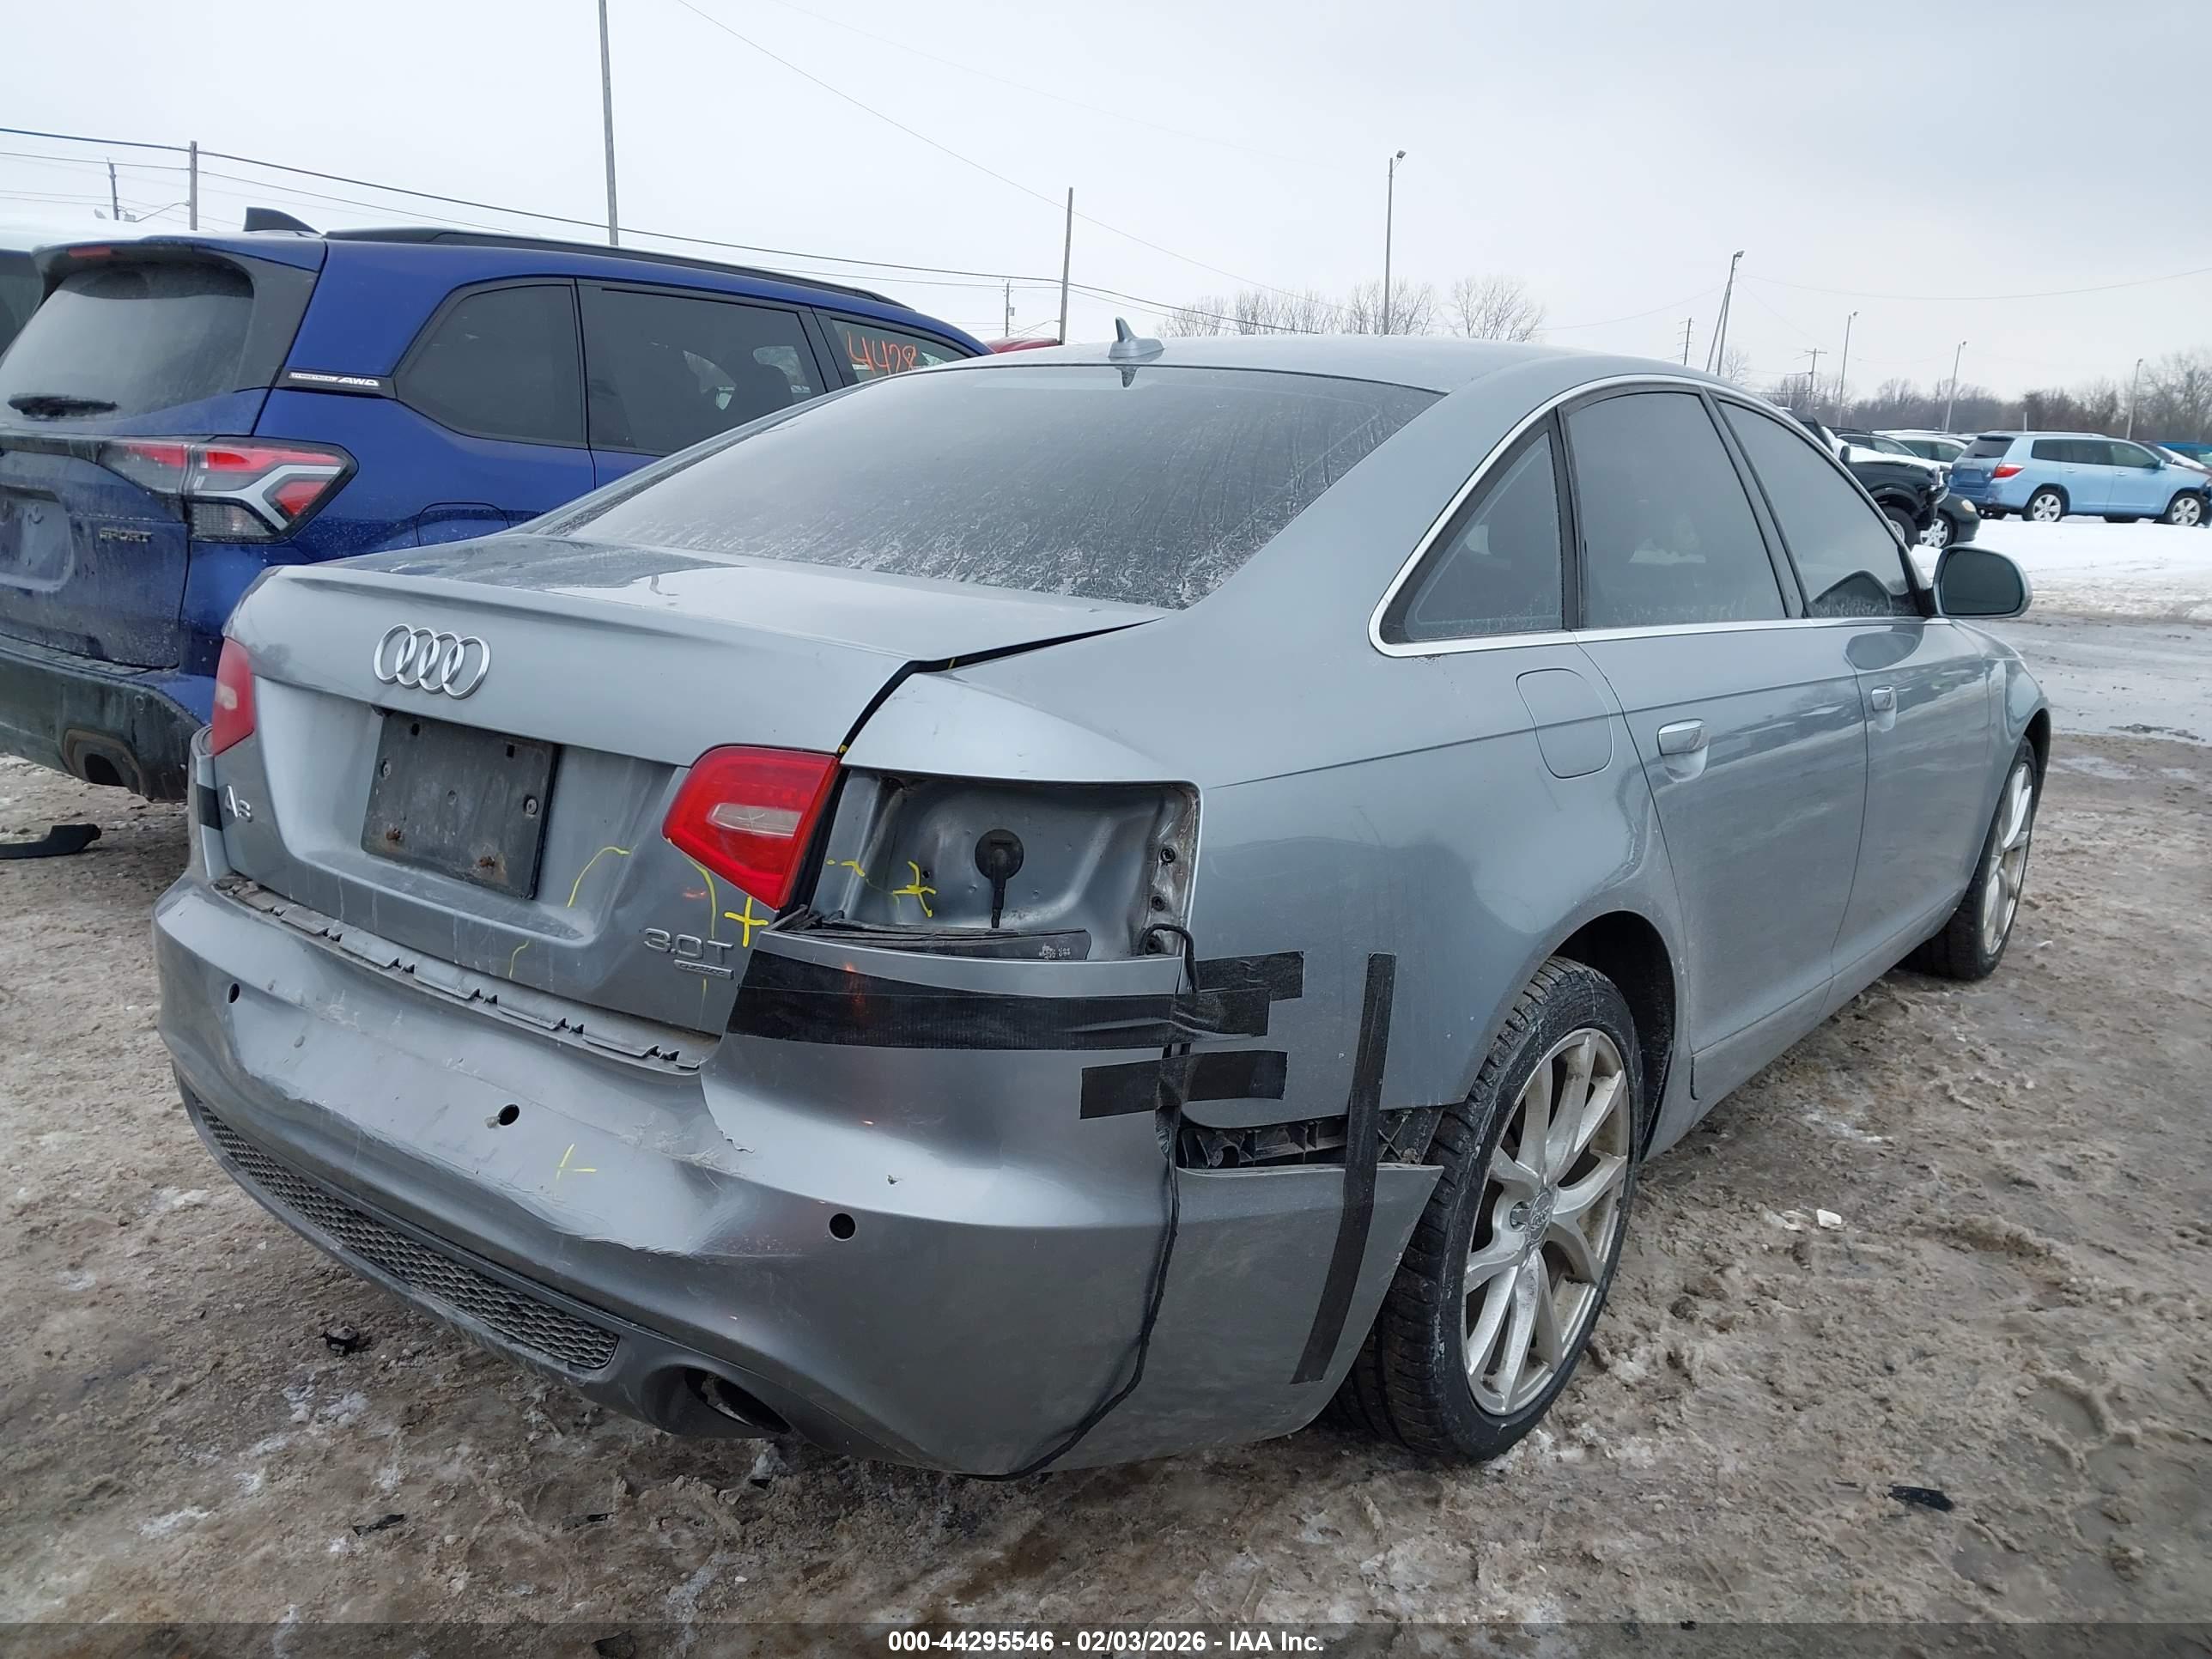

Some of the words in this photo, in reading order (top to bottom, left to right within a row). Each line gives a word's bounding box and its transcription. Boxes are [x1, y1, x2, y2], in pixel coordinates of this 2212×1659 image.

[337, 377, 380, 386] AWD
[224, 784, 251, 819] A6
[643, 927, 734, 963] 3.0T
